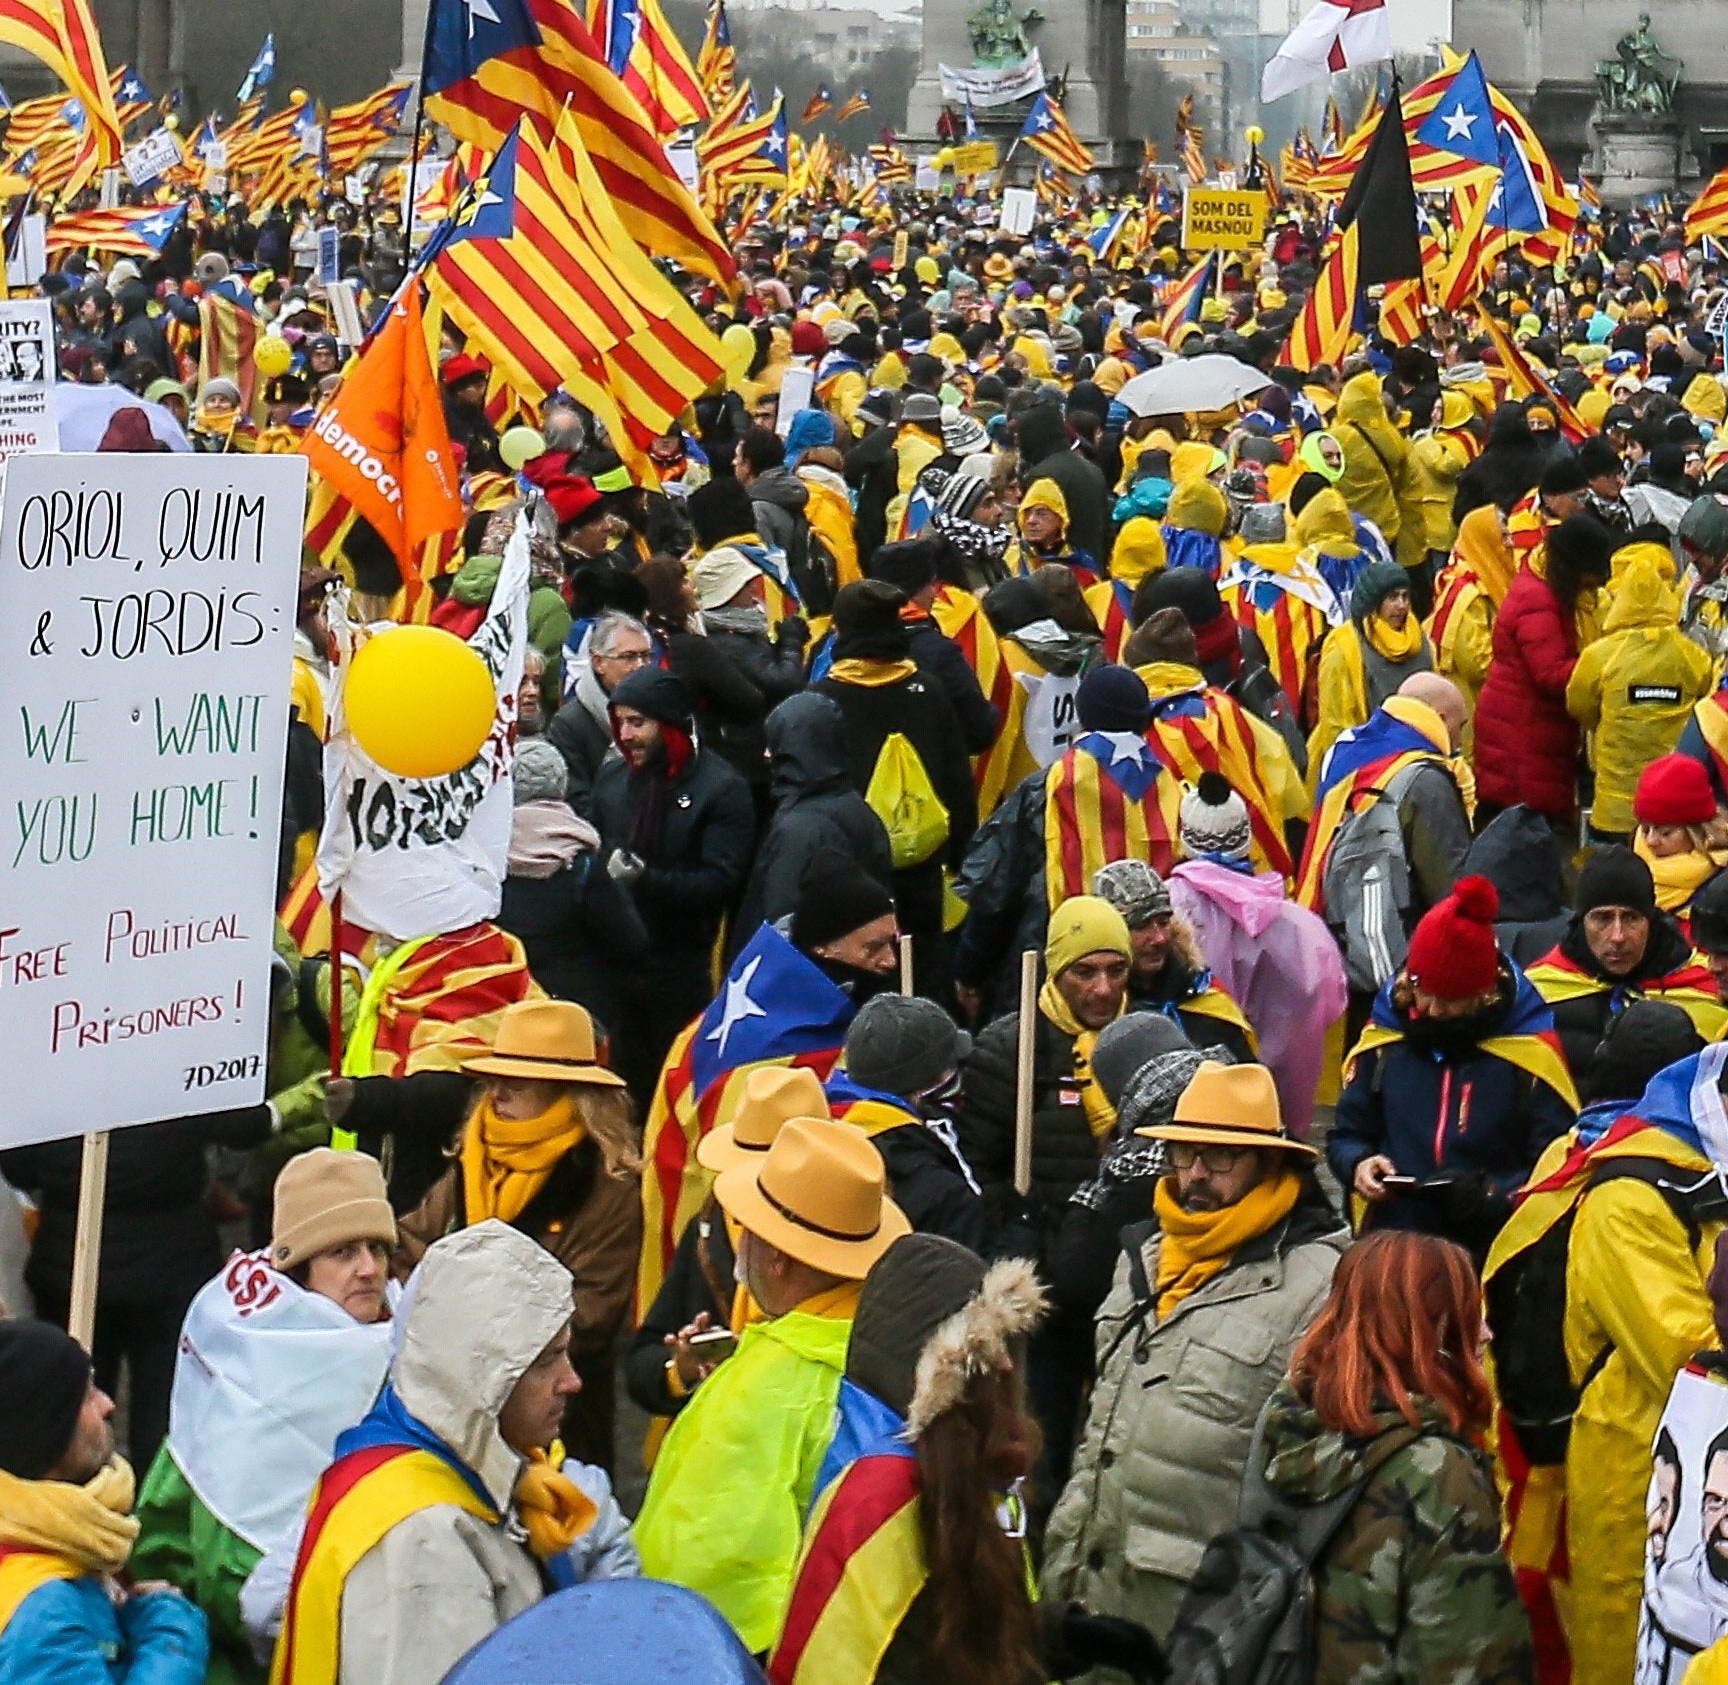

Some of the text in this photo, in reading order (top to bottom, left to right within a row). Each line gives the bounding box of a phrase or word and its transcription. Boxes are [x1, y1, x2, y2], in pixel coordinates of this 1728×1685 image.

[1192, 201, 1253, 217] SOM DEL
[1192, 219, 1253, 234] MASNOU
[18, 393, 45, 403] MOST
[19, 481, 265, 572] ORIOL, QUIM
[29, 586, 280, 660] & JORDIS:
[20, 694, 268, 765] WE WANT
[13, 794, 96, 869] YOU
